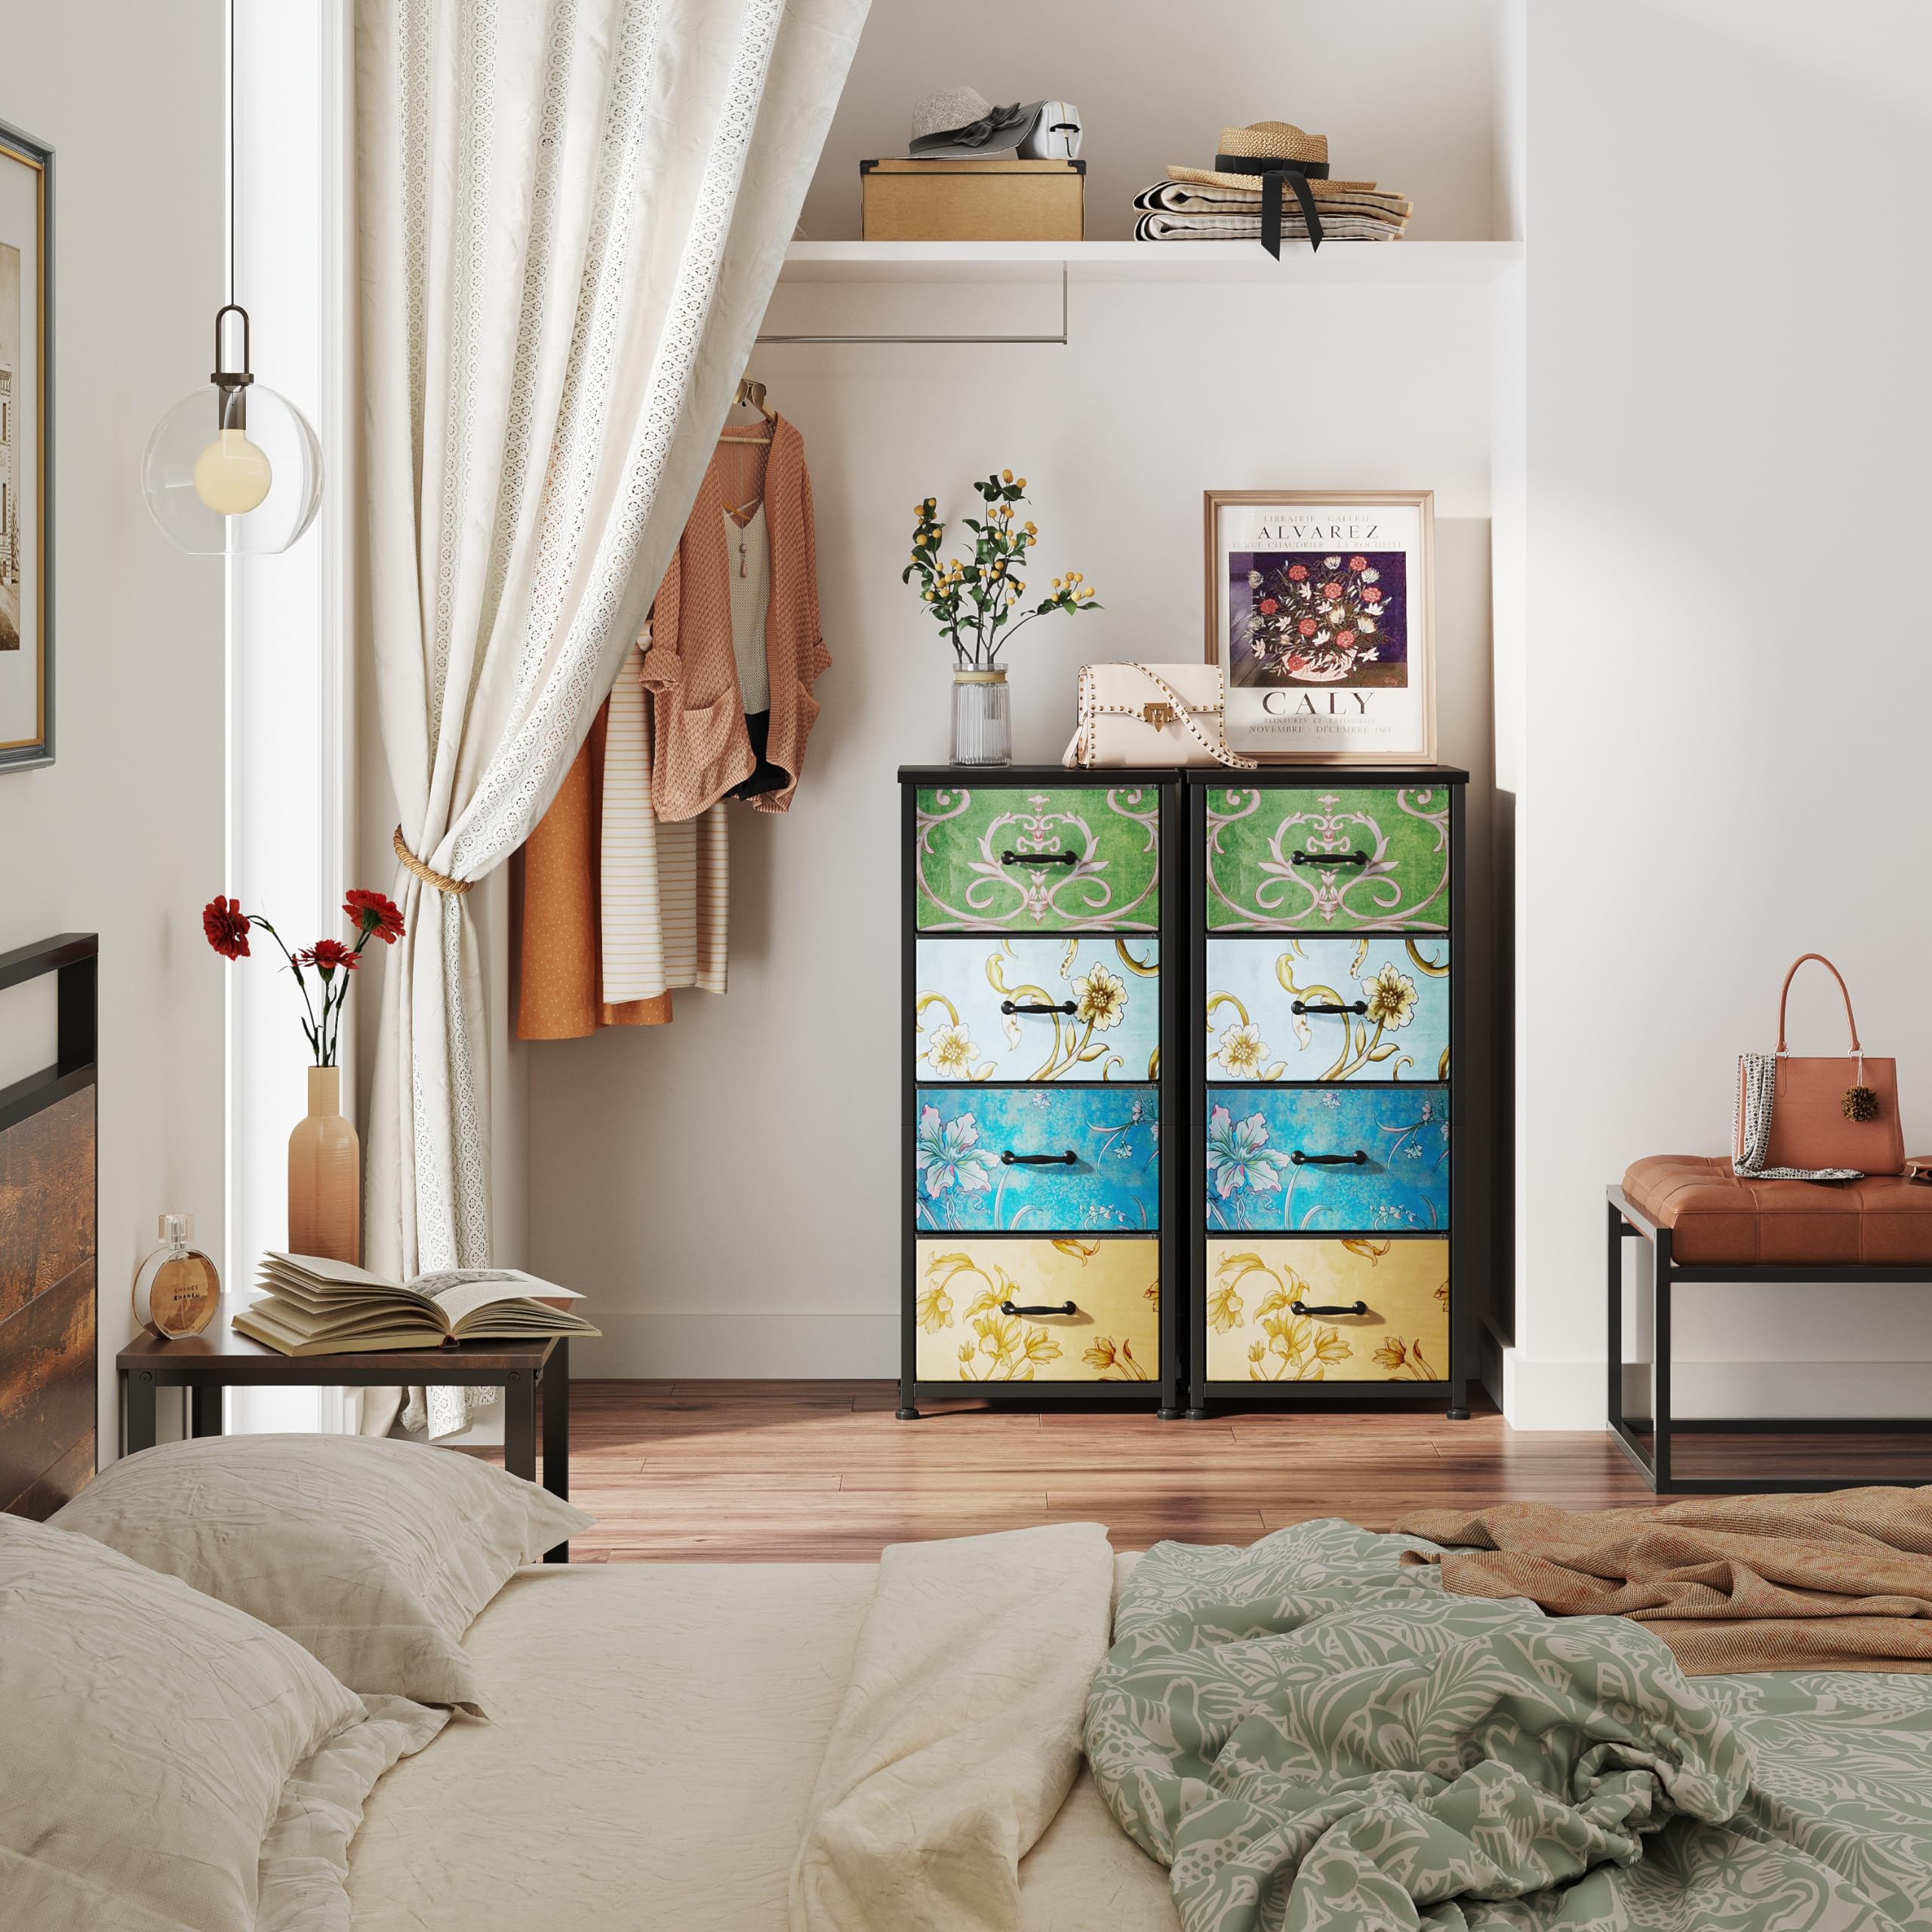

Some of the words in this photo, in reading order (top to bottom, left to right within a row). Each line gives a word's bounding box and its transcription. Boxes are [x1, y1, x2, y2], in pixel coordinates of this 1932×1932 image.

[1257, 525, 1380, 540] ALVAREZ
[1262, 691, 1376, 715] CALY
[1249, 725, 1304, 734] NOVEMBRE
